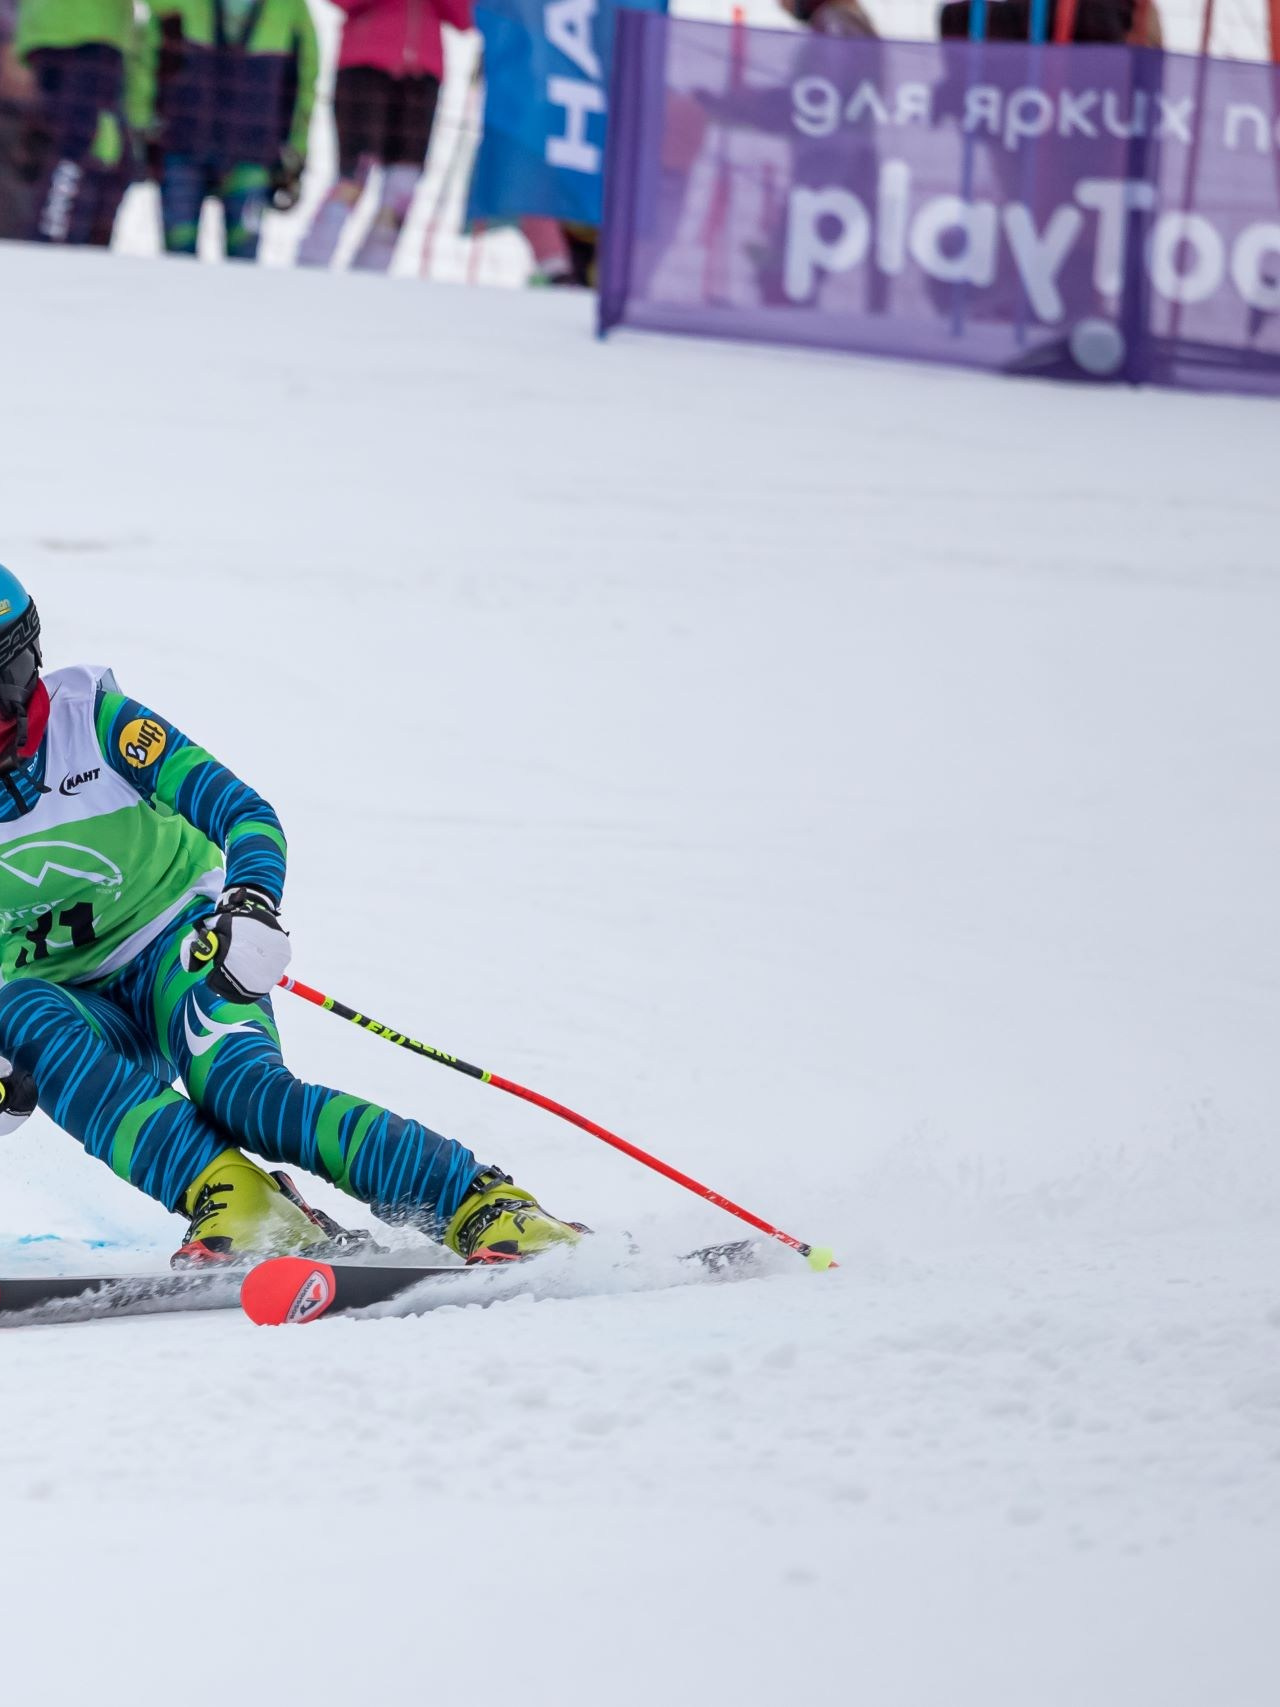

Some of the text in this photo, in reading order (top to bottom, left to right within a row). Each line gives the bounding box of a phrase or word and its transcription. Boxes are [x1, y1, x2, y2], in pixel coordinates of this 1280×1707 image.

[791, 76, 1280, 152] для ярких п
[66, 768, 101, 790] КАНТ
